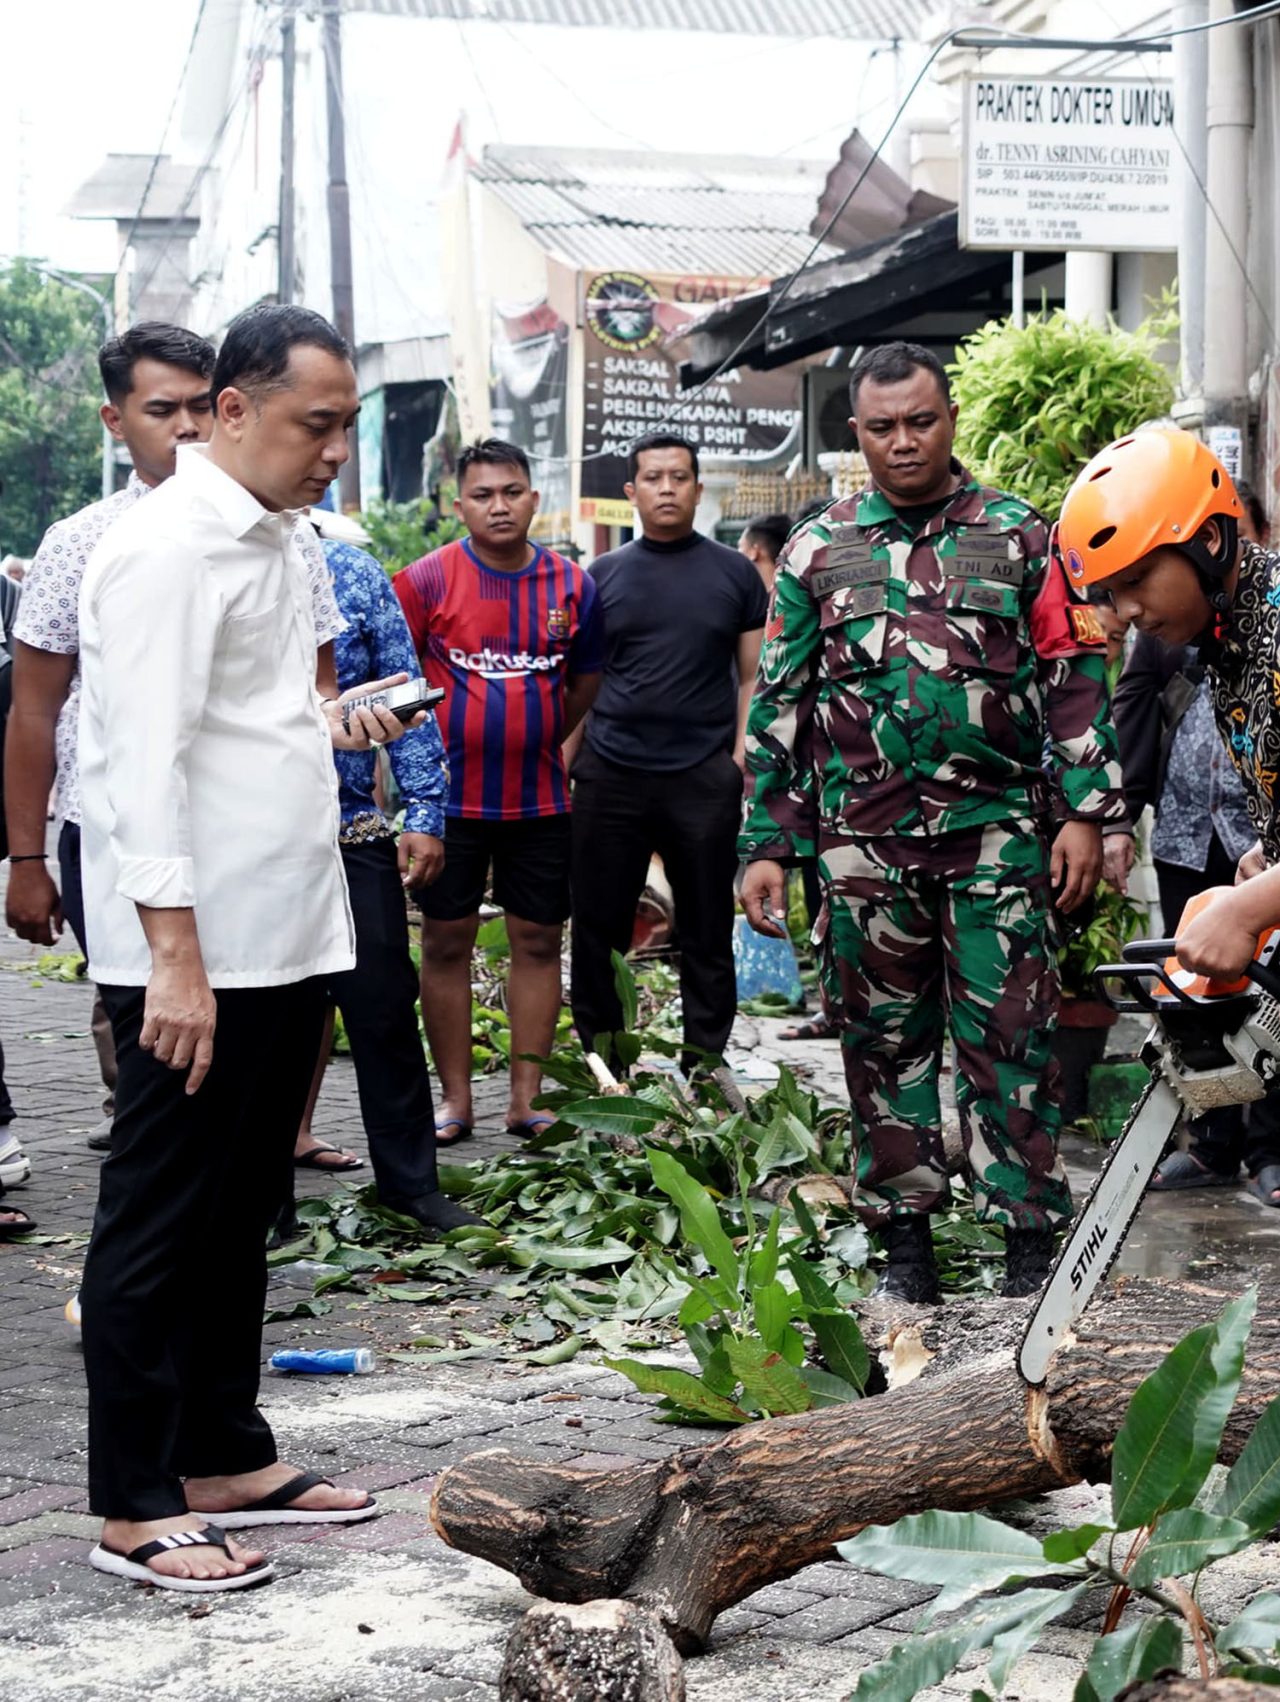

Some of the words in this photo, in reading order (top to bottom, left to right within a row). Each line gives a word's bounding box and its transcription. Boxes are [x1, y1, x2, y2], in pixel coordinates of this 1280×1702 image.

[976, 83, 1043, 122] PRAKTEK
[1051, 86, 1114, 125] DOKTER
[1121, 88, 1174, 127] UMUM
[976, 141, 993, 160] dr.
[603, 356, 670, 379] SAKRAL
[603, 377, 671, 399] SAKRAL
[602, 398, 741, 424] PERLENGKAPAN
[704, 425, 747, 445] PSHT
[953, 560, 981, 573] TNI
[991, 562, 1013, 577] AD
[1070, 1223, 1108, 1292] STIHL
